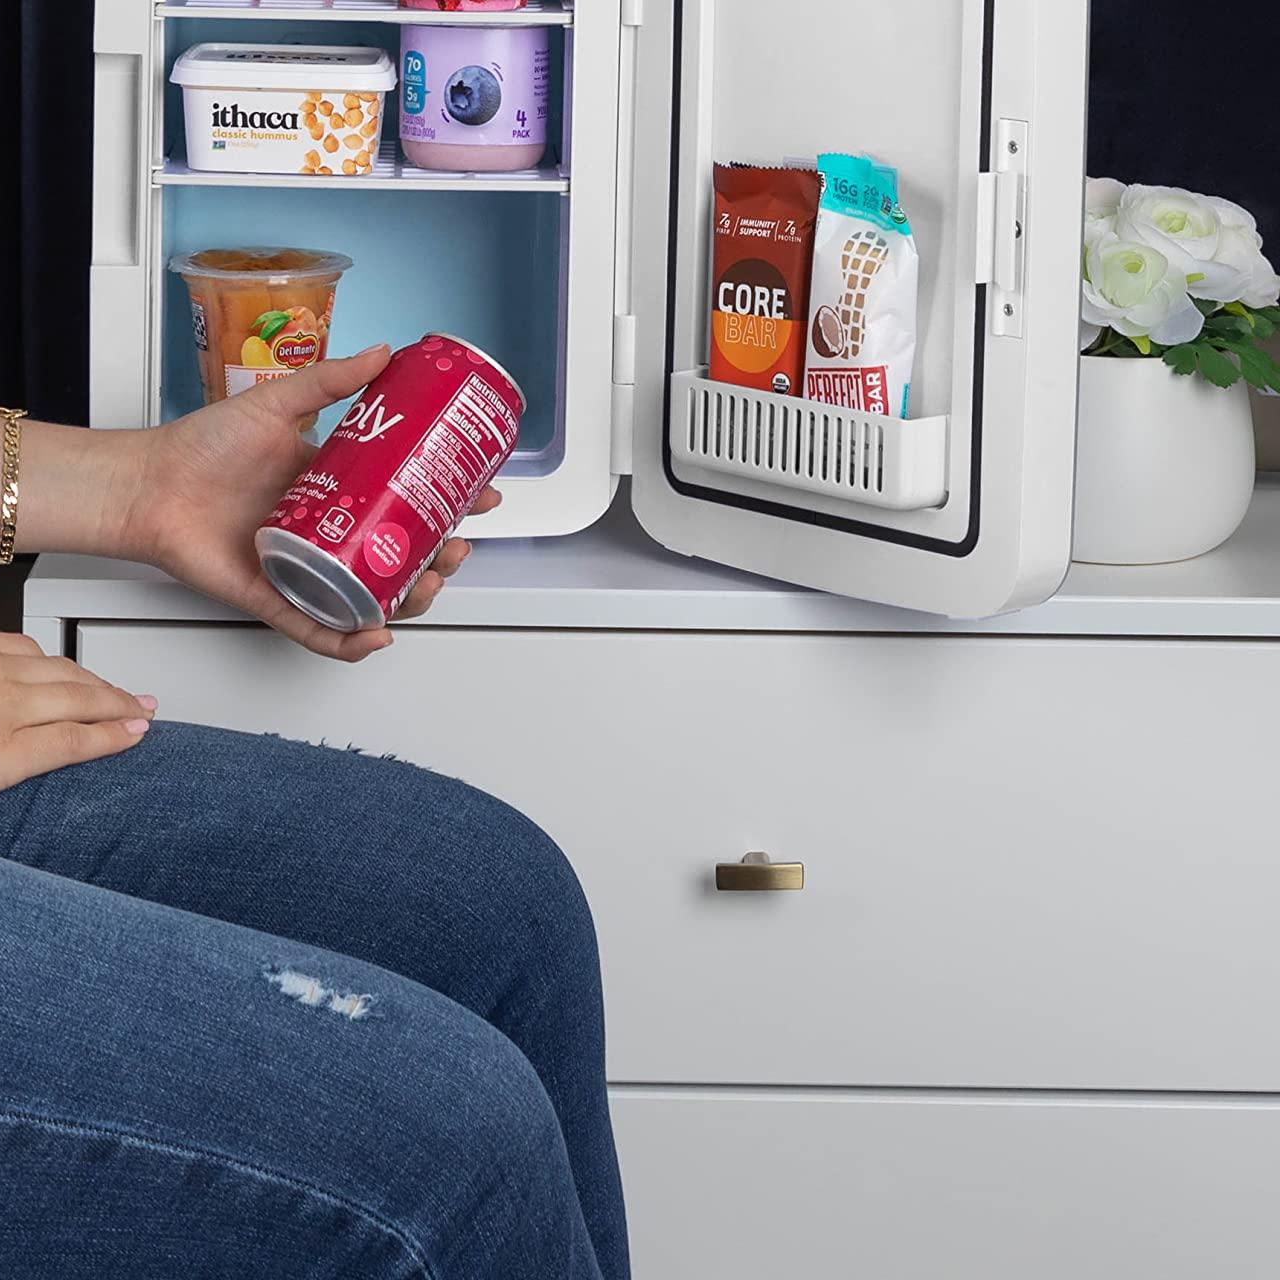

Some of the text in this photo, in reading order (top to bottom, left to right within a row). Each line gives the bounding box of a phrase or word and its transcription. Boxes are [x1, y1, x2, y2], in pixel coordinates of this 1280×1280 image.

[407, 56, 421, 74] 70
[407, 86, 418, 102] 5g
[212, 103, 298, 130] ithaca
[516, 109, 527, 127] 4
[212, 129, 298, 141] classic hummus
[513, 130, 530, 138] PACK
[833, 177, 858, 197] 16G
[720, 213, 731, 228] 7g
[740, 218, 776, 229] IMMUNITY
[785, 220, 796, 236] 7g
[739, 228, 771, 238] SUPPORT
[778, 234, 802, 243] PROTEIN
[718, 282, 786, 320] CORE
[725, 312, 776, 349] BAR
[279, 344, 316, 356] Del Monte
[469, 375, 507, 414] Nutrition
[808, 373, 860, 410] PERFECT
[866, 372, 884, 414] BAR
[462, 385, 486, 409] Serving
[483, 404, 497, 419] size
[446, 405, 500, 467] Calories 0
[304, 470, 337, 491] bubly
[307, 488, 327, 500] other
[334, 514, 345, 526] 0
[383, 533, 401, 553] did we
[372, 543, 393, 567] besties?
[382, 542, 401, 565] become
